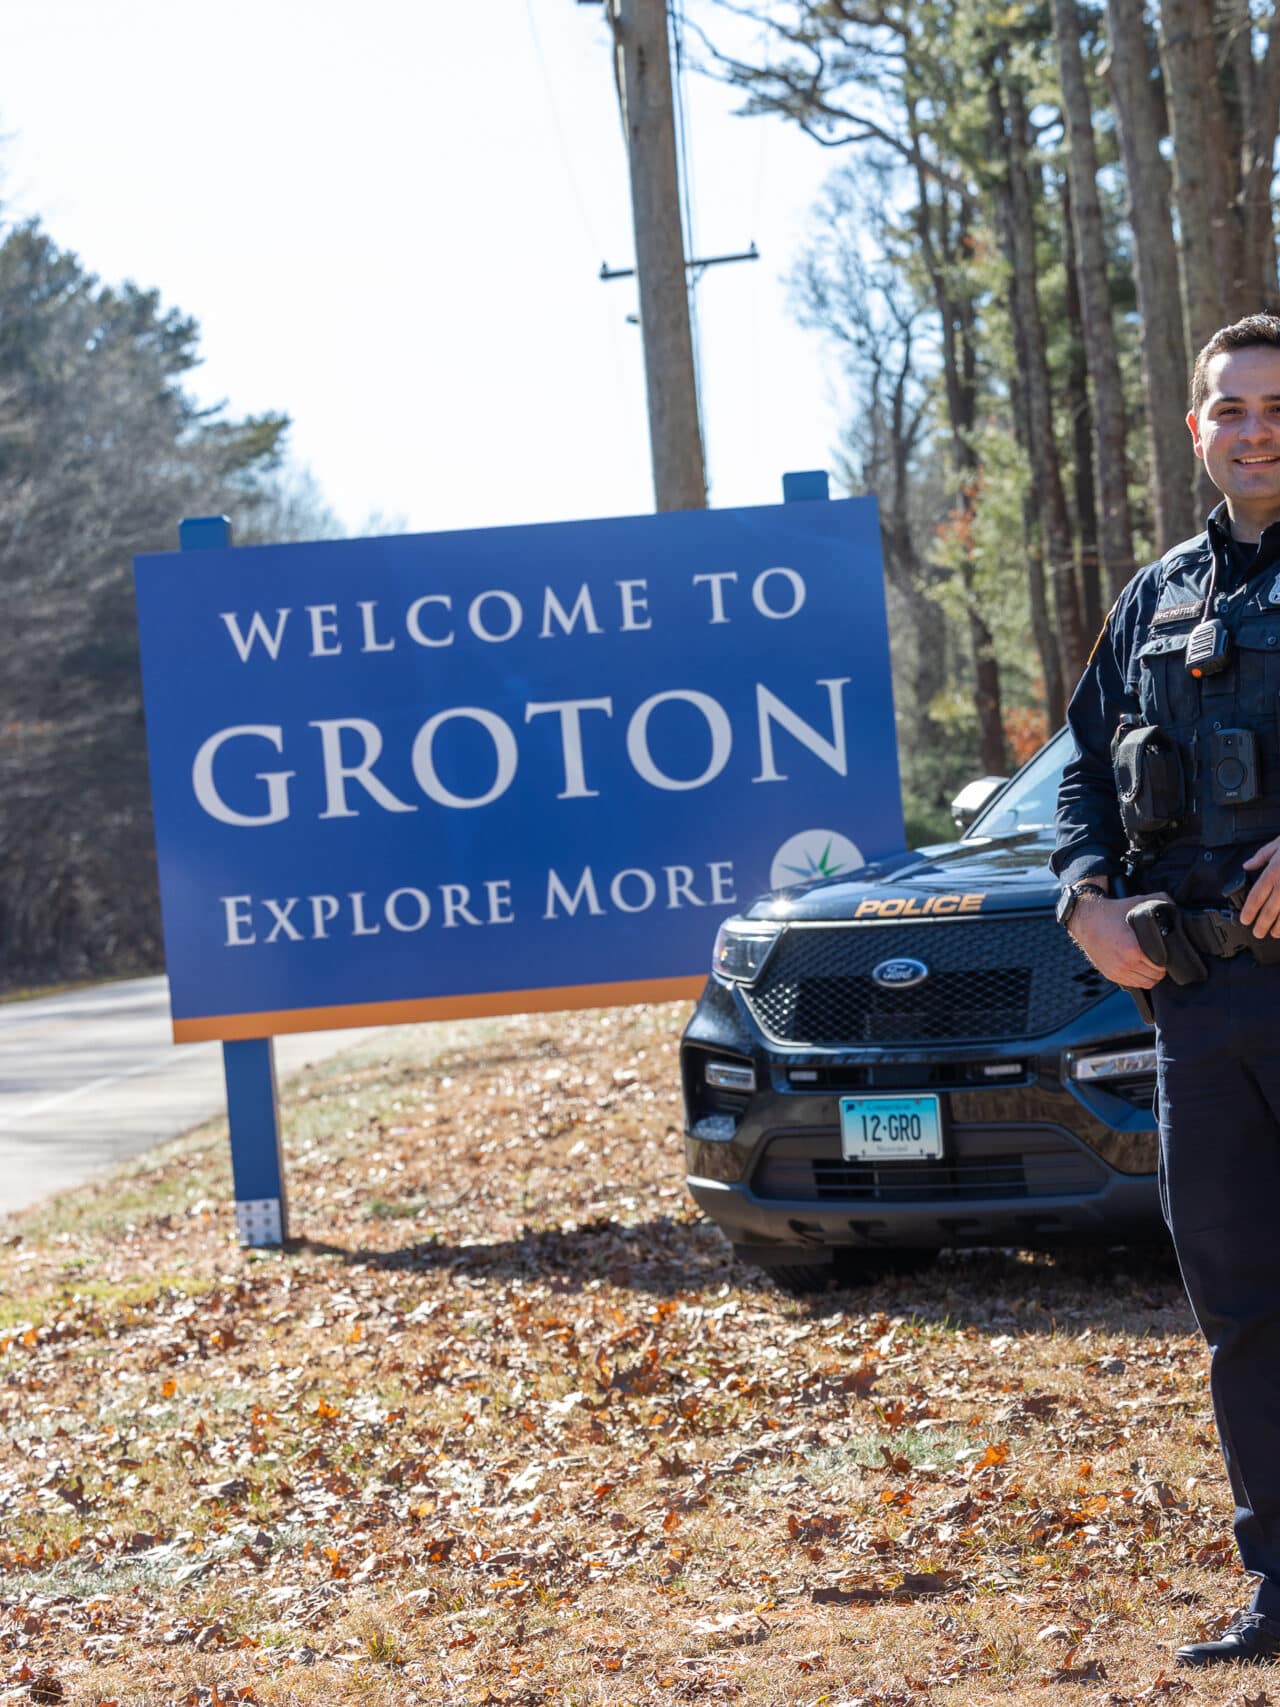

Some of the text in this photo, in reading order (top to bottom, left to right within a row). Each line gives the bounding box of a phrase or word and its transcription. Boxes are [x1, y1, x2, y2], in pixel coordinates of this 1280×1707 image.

[220, 567, 806, 662] WELCOME TO
[192, 677, 851, 828] GROTON
[221, 861, 738, 946] EXPLORE MORE
[854, 892, 986, 918] POLICE
